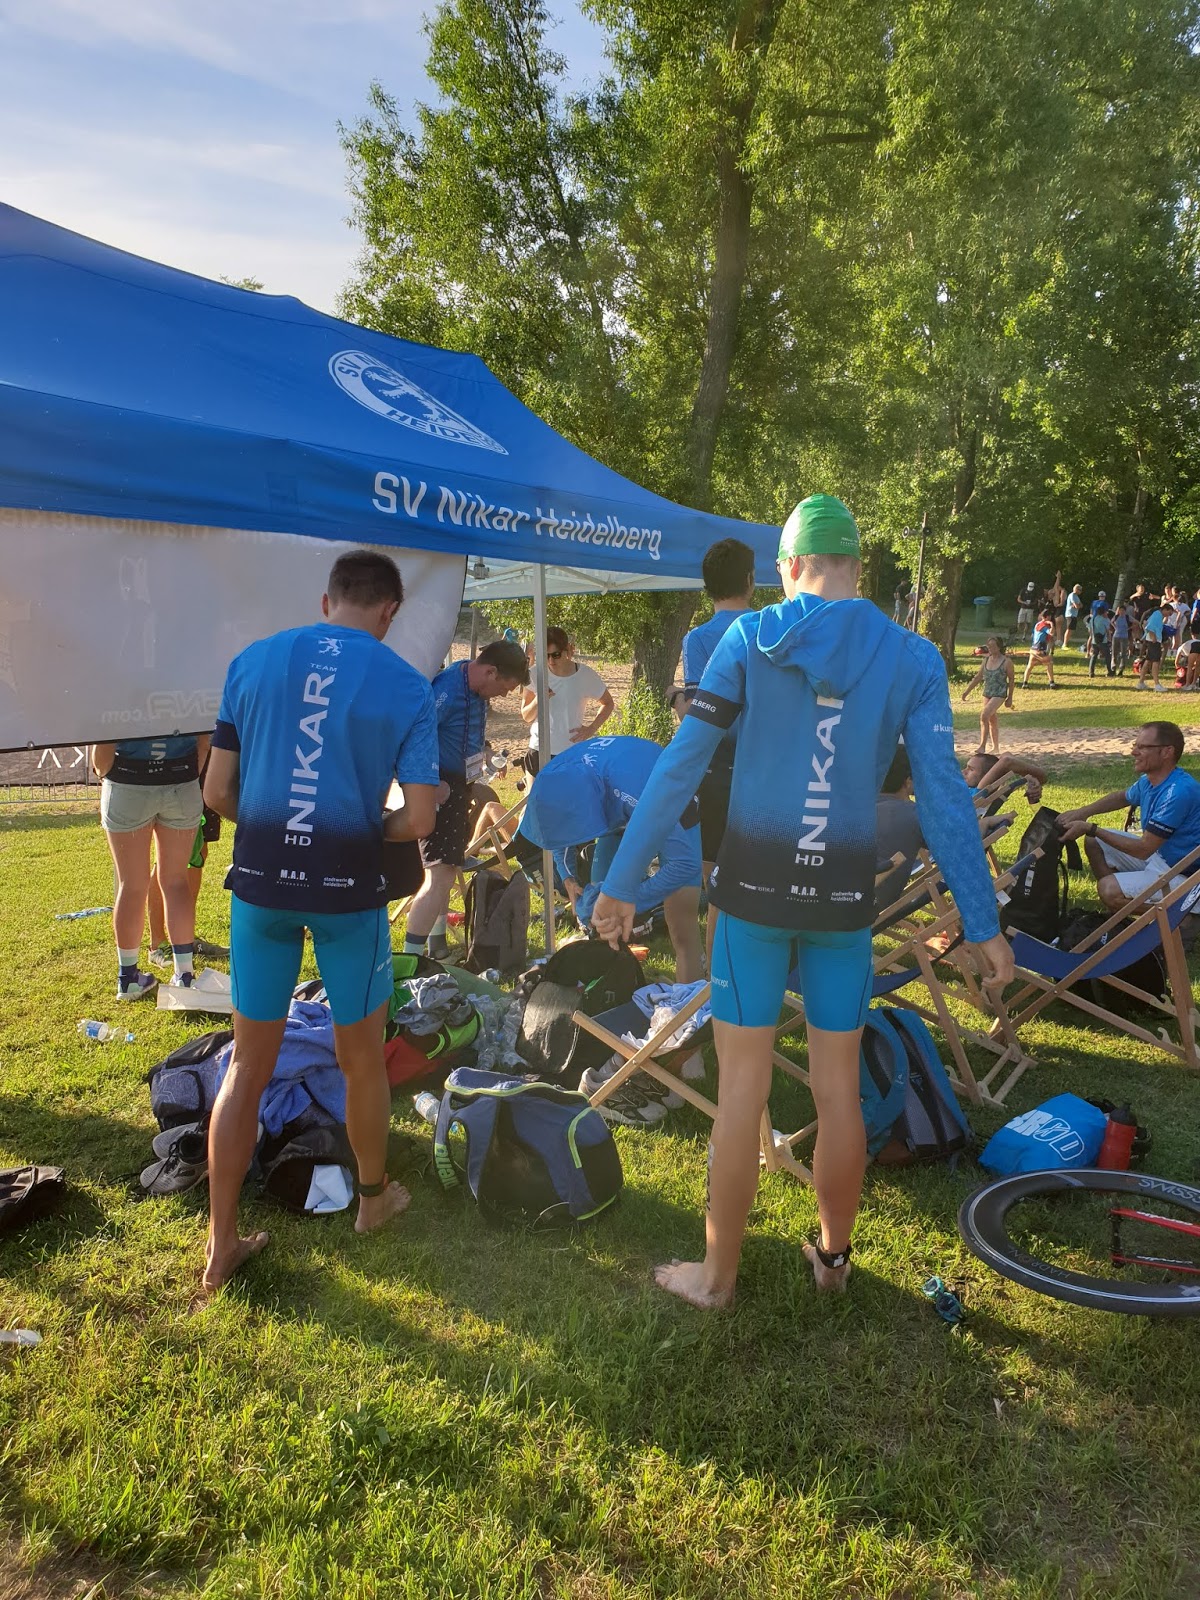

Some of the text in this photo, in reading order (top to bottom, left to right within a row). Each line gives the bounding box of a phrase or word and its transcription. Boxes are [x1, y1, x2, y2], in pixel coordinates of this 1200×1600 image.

[372, 471, 662, 560] SV Nikar Heidelberg
[310, 663, 338, 672] TEAM
[286, 672, 336, 832] NIKAR
[284, 834, 312, 847] HD
[795, 853, 824, 867] HD
[280, 869, 308, 881] M.A.D.
[790, 884, 818, 896] M.A.D.
